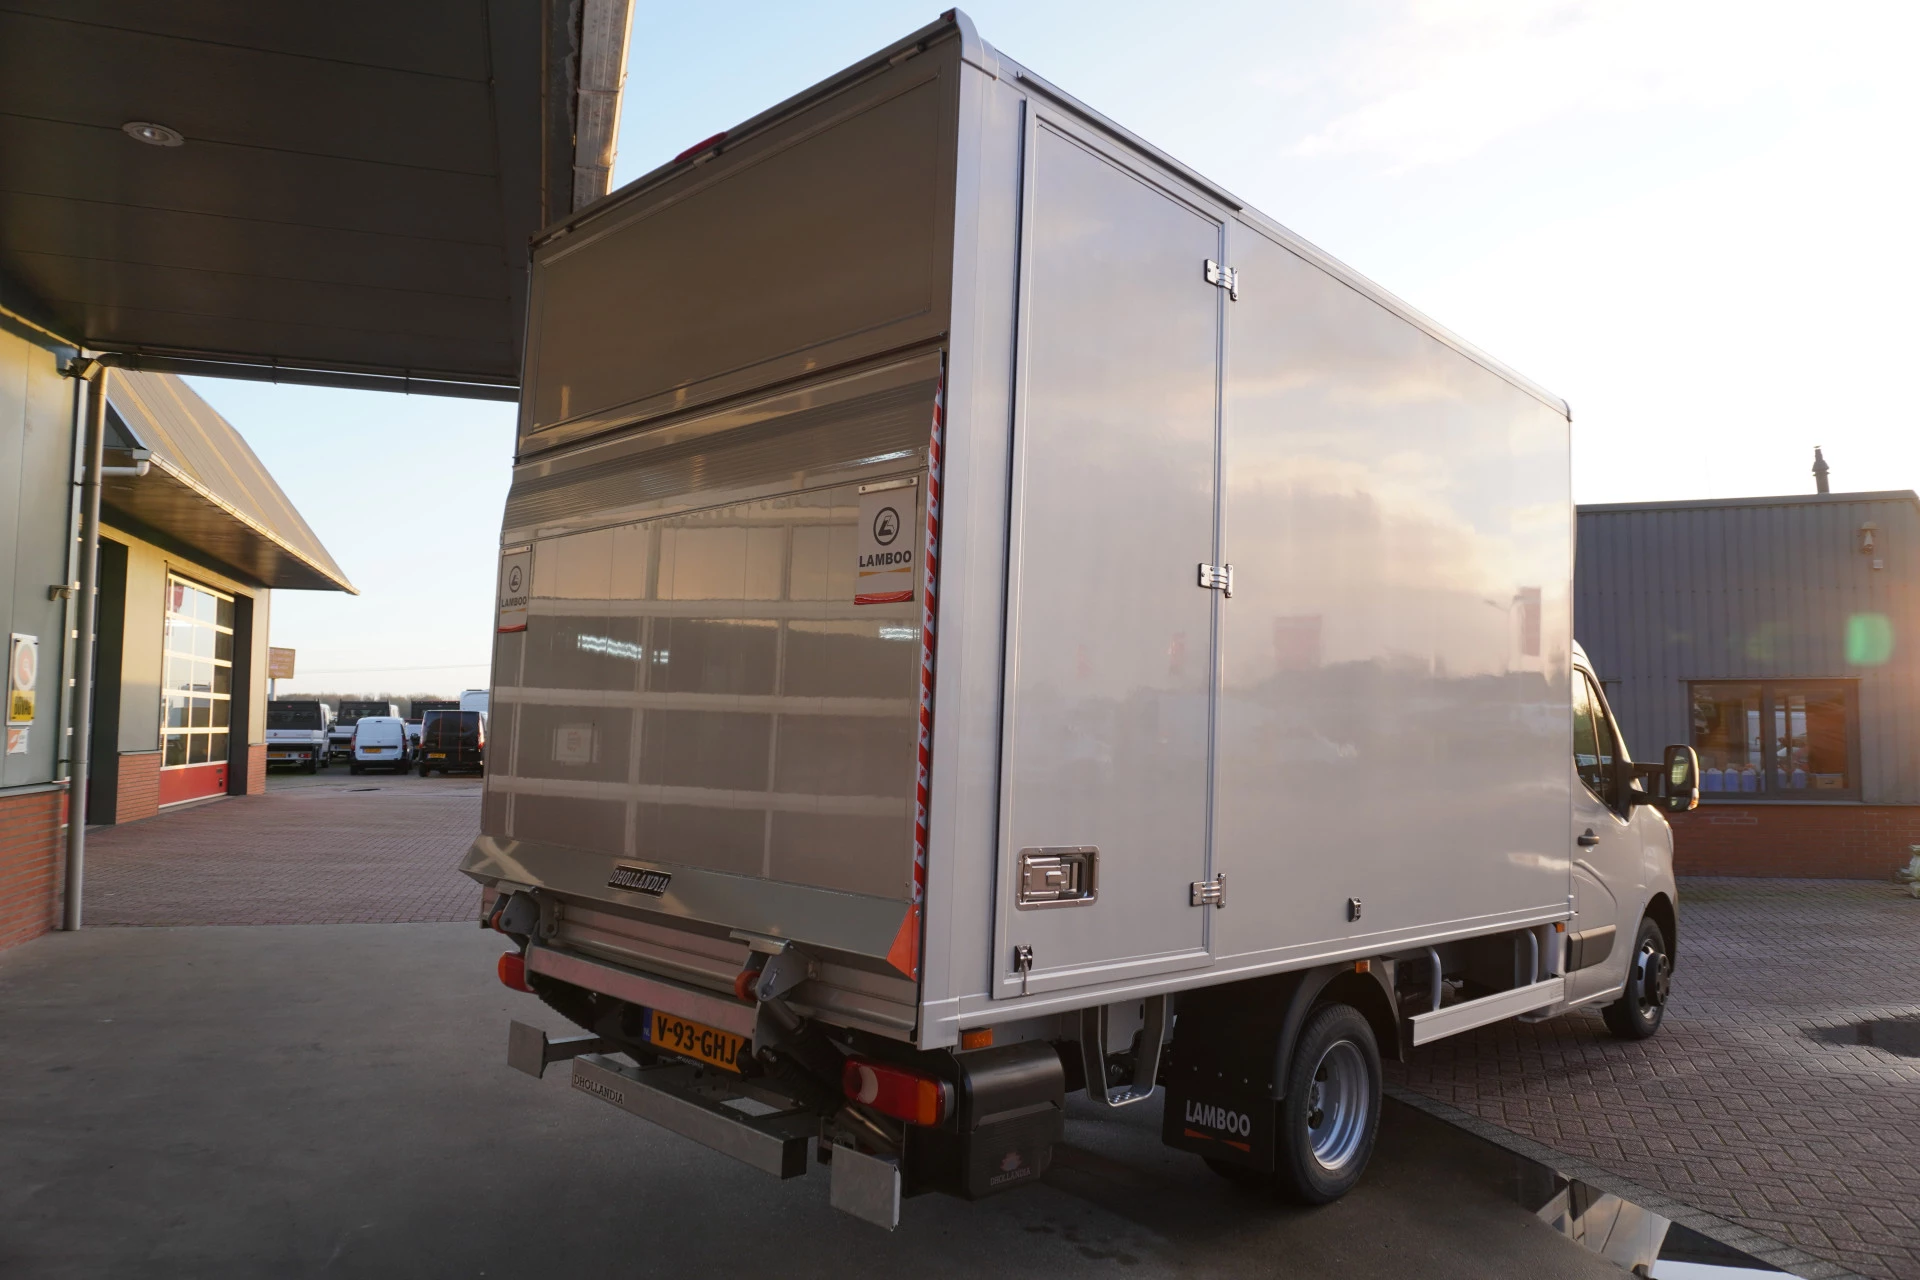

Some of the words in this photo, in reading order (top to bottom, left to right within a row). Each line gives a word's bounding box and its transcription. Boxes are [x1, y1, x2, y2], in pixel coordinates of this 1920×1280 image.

[859, 550, 912, 568] LAMBOO
[501, 596, 527, 607] LAMBOO
[609, 869, 669, 893] DHOLLANDIA
[657, 1016, 736, 1065] V-93-GHJ
[574, 1074, 623, 1104] DHOLLANDIA
[1185, 1099, 1251, 1137] LAMBOO
